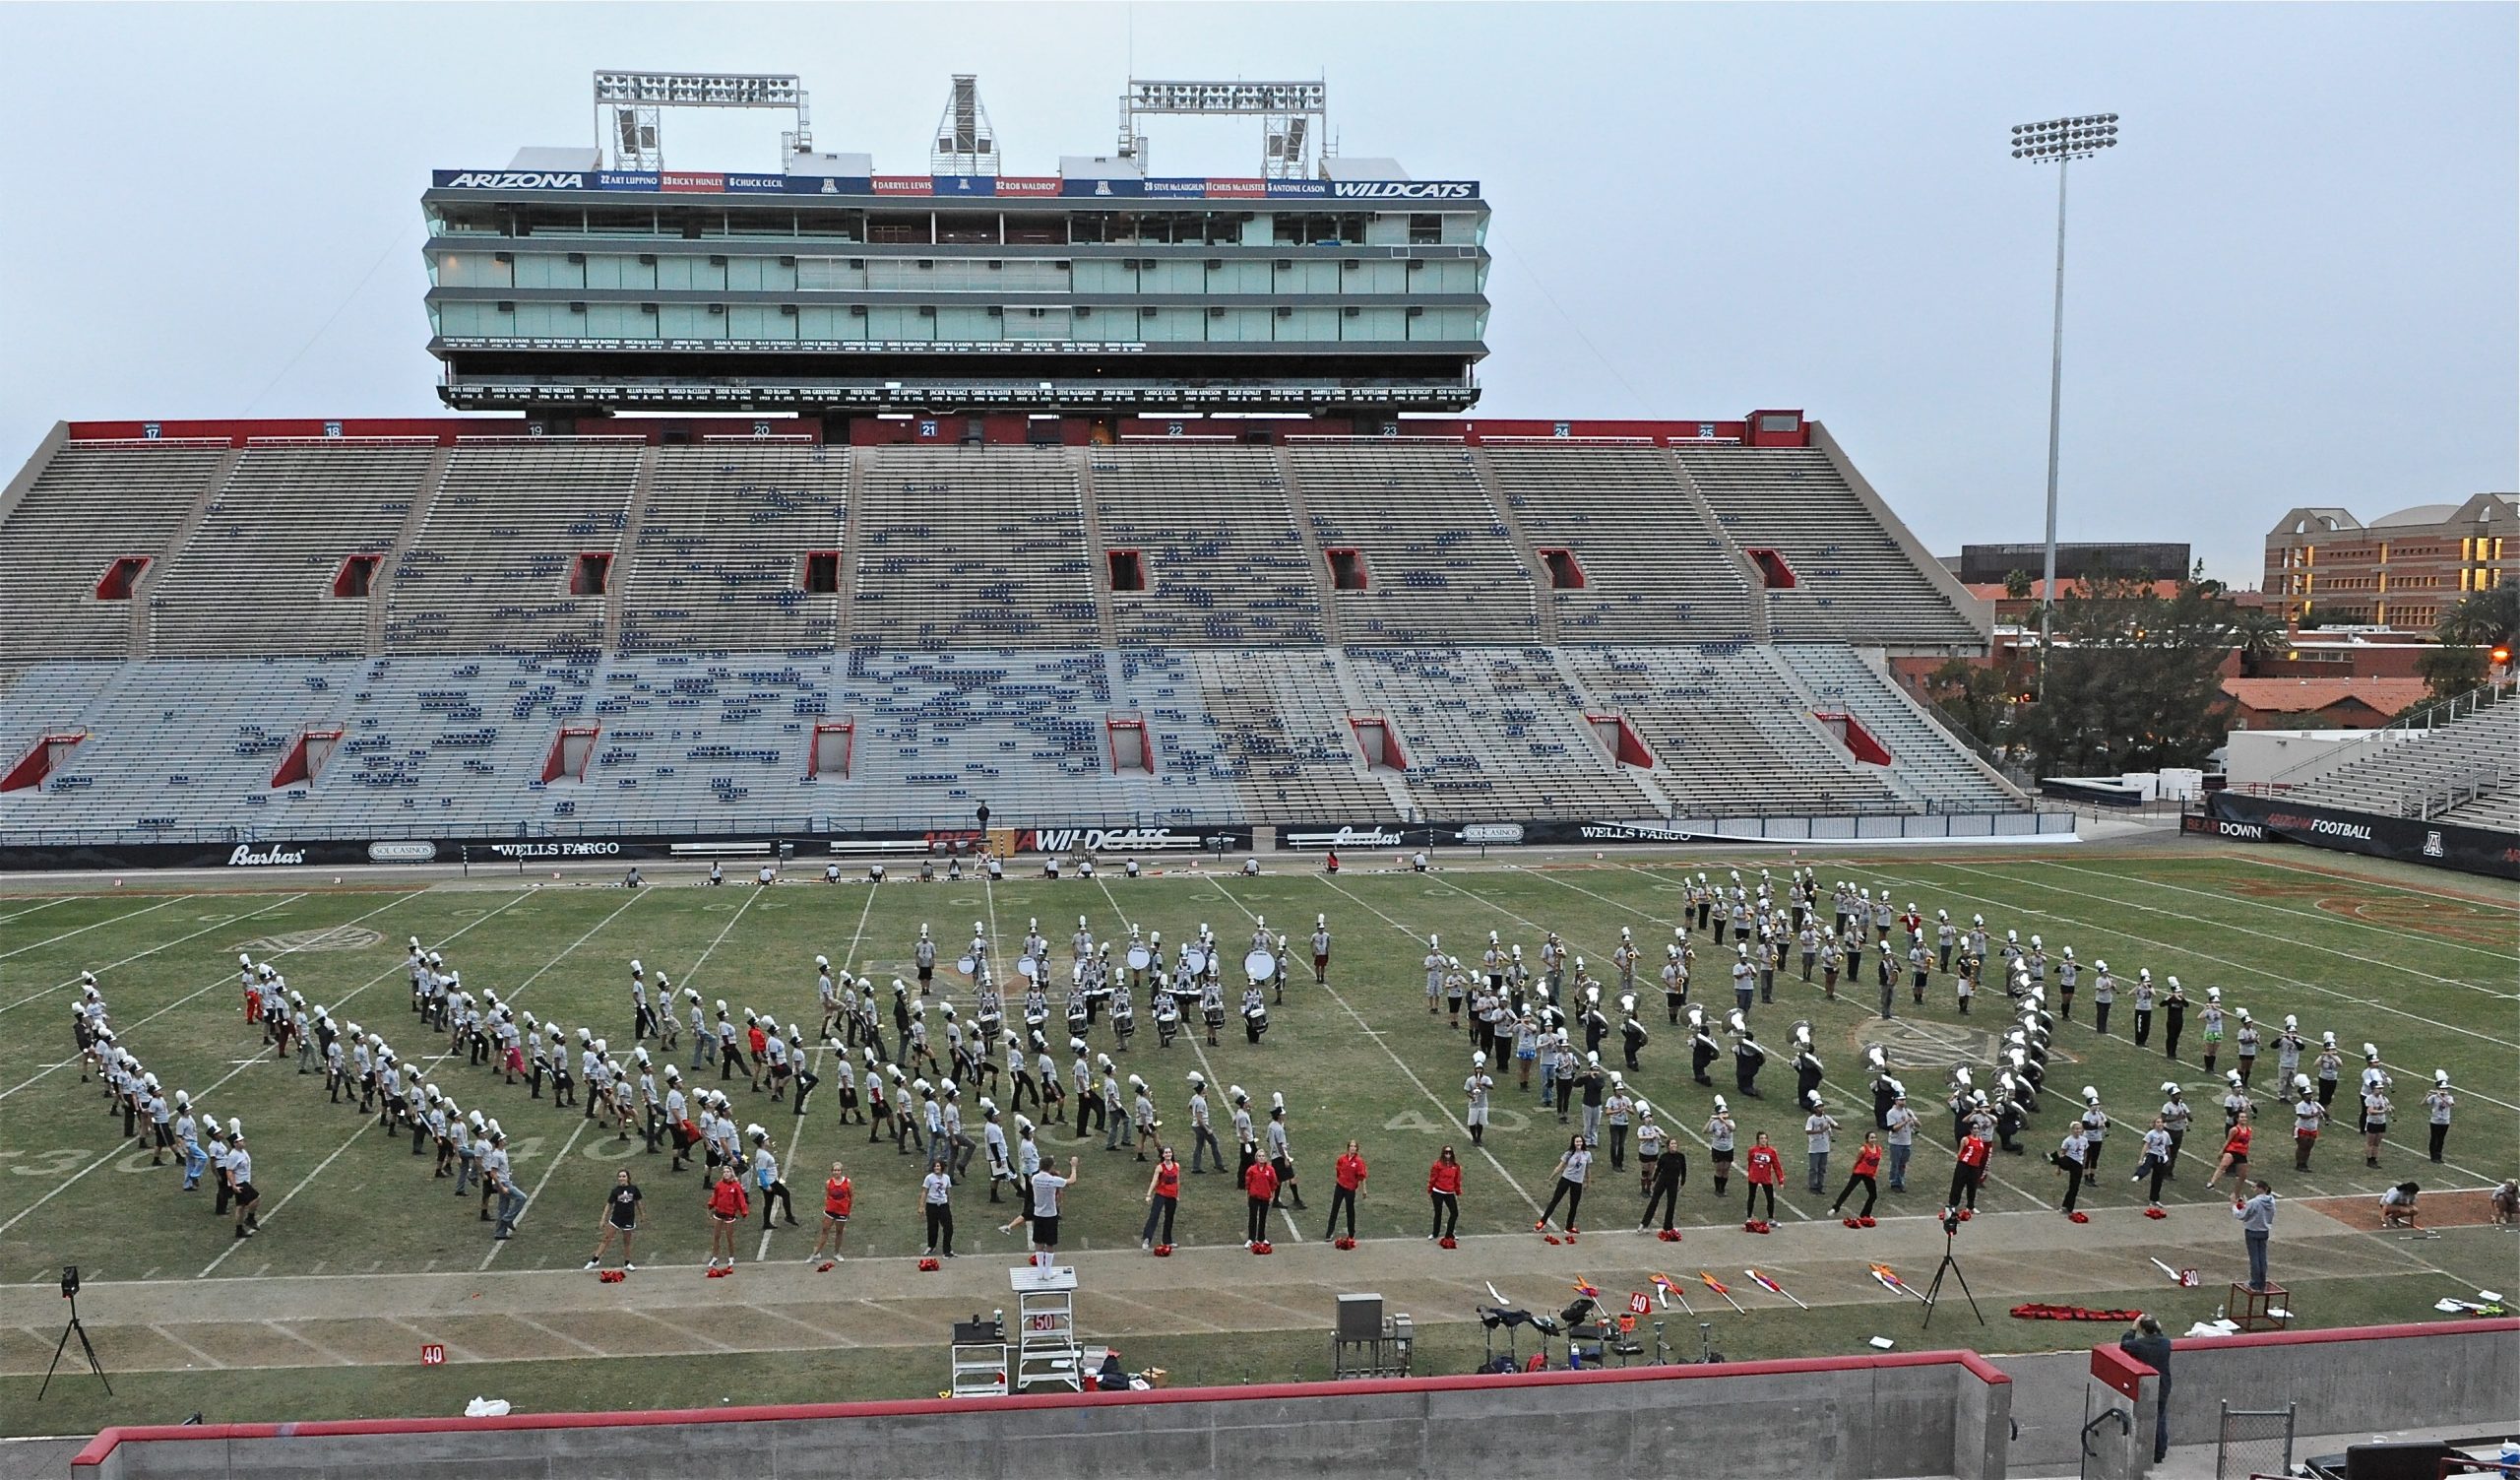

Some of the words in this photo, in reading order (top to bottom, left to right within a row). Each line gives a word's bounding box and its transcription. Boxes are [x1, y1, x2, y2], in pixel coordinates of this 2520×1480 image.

[448, 173, 583, 188] ARIZONA
[600, 175, 610, 184] 22
[610, 176, 624, 185] ART
[626, 176, 658, 185] LUPPINO
[672, 177, 694, 186] RICKY
[696, 177, 724, 187] HUNLEY
[729, 178, 735, 187] 6
[763, 179, 784, 188] CECIL
[872, 180, 878, 189] 4
[879, 180, 910, 189] DARRYLL
[912, 181, 932, 190] LEWIS
[1022, 182, 1055, 191] WALDROP
[1144, 182, 1153, 191] 28
[1206, 182, 1213, 191] 11
[1232, 183, 1265, 192] McALISTER
[1273, 184, 1300, 193] ANTOINE
[1301, 184, 1325, 193] CASON
[1335, 183, 1472, 198] WILDCATS
[147, 428, 158, 439] 17
[327, 427, 340, 437] 18
[530, 426, 542, 436] 19
[754, 425, 770, 435] 20
[922, 425, 935, 435] 21
[1169, 425, 1182, 435] 22
[1384, 426, 1397, 436] 23
[1555, 427, 1568, 437] 24
[1700, 428, 1713, 438] 25
[1580, 827, 1635, 838] WELLS
[2186, 818, 2218, 835] BEAR
[2221, 821, 2261, 838] DOWN
[2311, 819, 2371, 839] FOOTBALL
[500, 844, 558, 855] WELLS
[562, 842, 620, 854] FARGO
[228, 844, 306, 865] Bashas'
[2183, 1270, 2198, 1286] 30
[1631, 1295, 1647, 1312] 40
[1037, 1315, 1053, 1330] 50
[423, 1347, 442, 1363] 40
